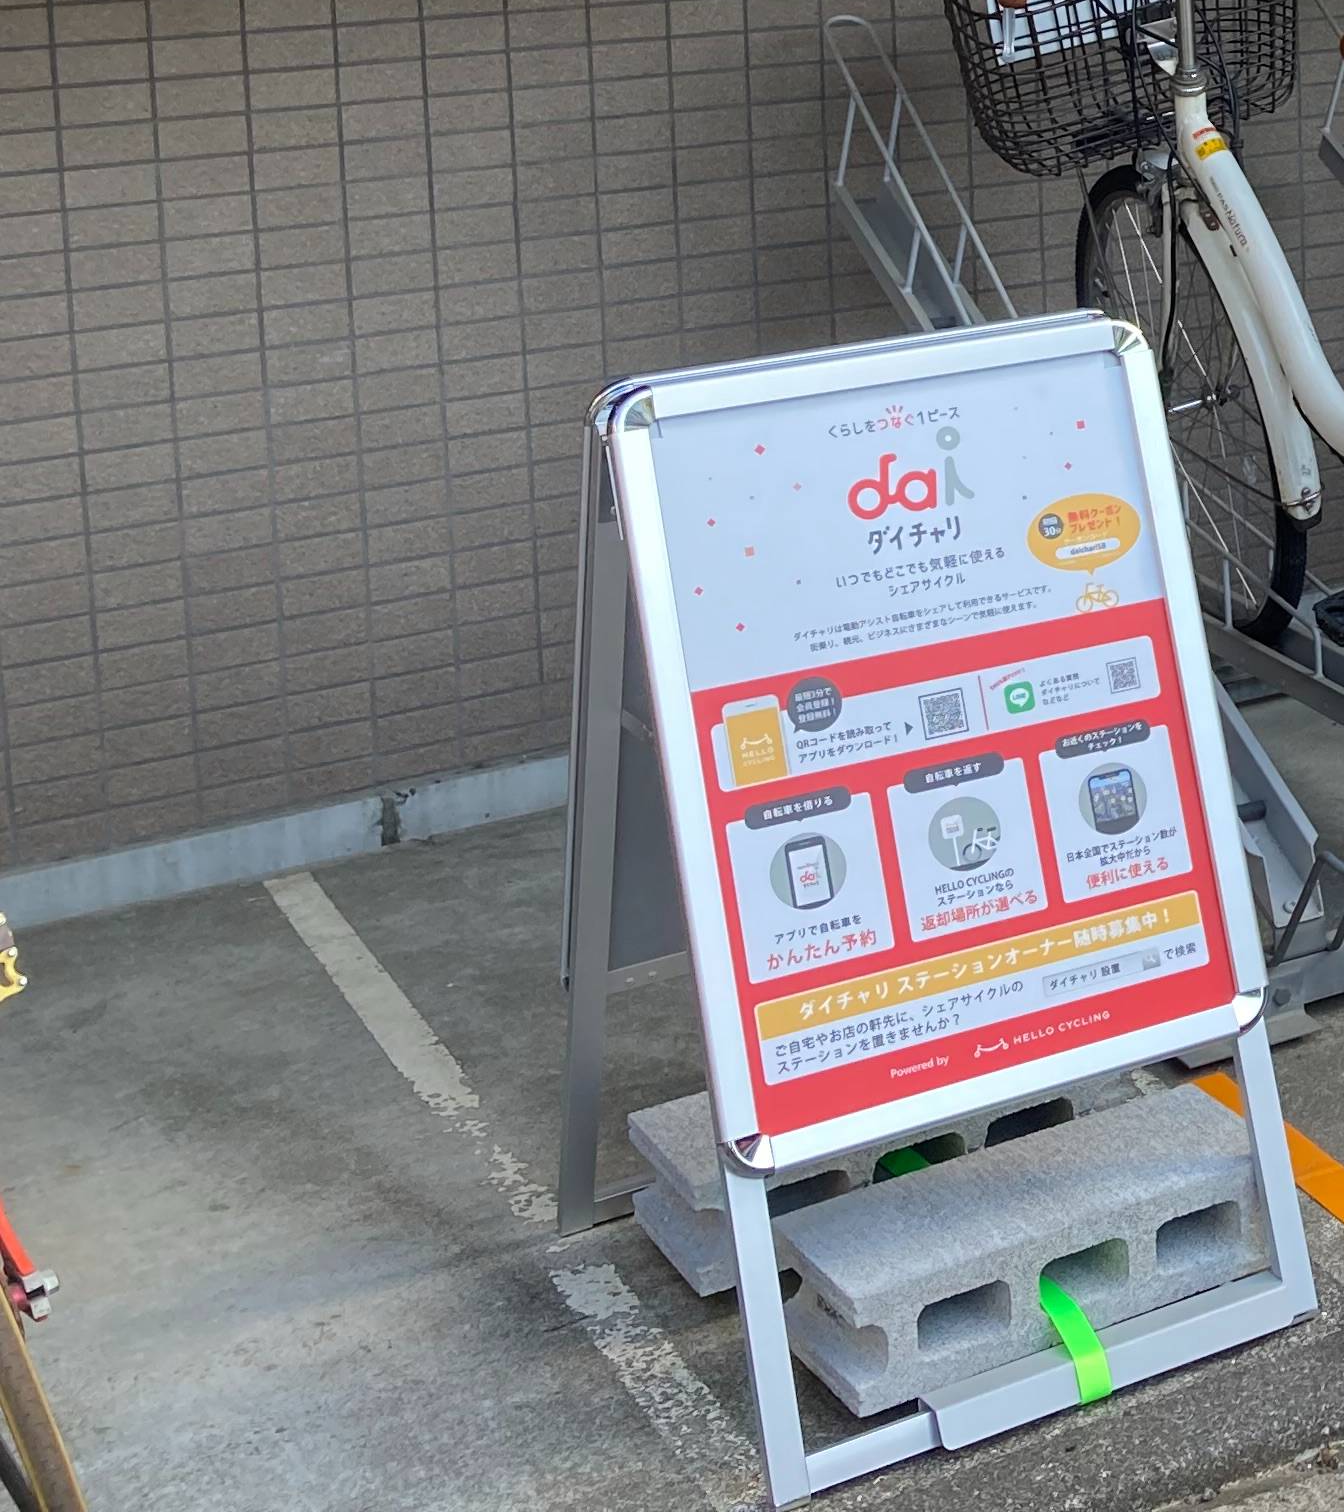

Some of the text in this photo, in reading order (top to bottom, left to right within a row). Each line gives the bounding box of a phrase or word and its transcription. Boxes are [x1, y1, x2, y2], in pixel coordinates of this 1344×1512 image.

[867, 515, 962, 555] ダイチャリ
[835, 546, 1006, 588] いつでもどこでも気軽に使える
[888, 572, 966, 598] シェアサイクル
[796, 721, 892, 750] QRコードを読み取って
[798, 733, 899, 764] アプリをダウンロード！
[924, 761, 982, 784] 自転車を返す
[762, 794, 834, 821] 自転車を借りる
[1066, 826, 1177, 863] 日本全国でステーション数が
[1099, 845, 1151, 867] 拡大中だから
[934, 867, 1015, 895] HELLO CYCLINGの
[1086, 856, 1169, 890] 便利に使える
[937, 879, 1014, 907] ステーションなら
[920, 889, 1038, 931] 返却場所が選べる
[774, 914, 862, 945] アプリで自転車を
[766, 927, 877, 971] かんたん予約
[1163, 941, 1198, 960] で検索
[1049, 962, 1121, 991] ダイチャリ 設置
[799, 982, 889, 1020] ダイチャリ
[775, 980, 1024, 1058] ご自宅やお店の軒先に、シェアサイクルの
[1012, 1010, 1111, 1045] HELLO CYCLING
[777, 1013, 961, 1075] ステーションを置きませんか？
[889, 1054, 950, 1078] Powered by
